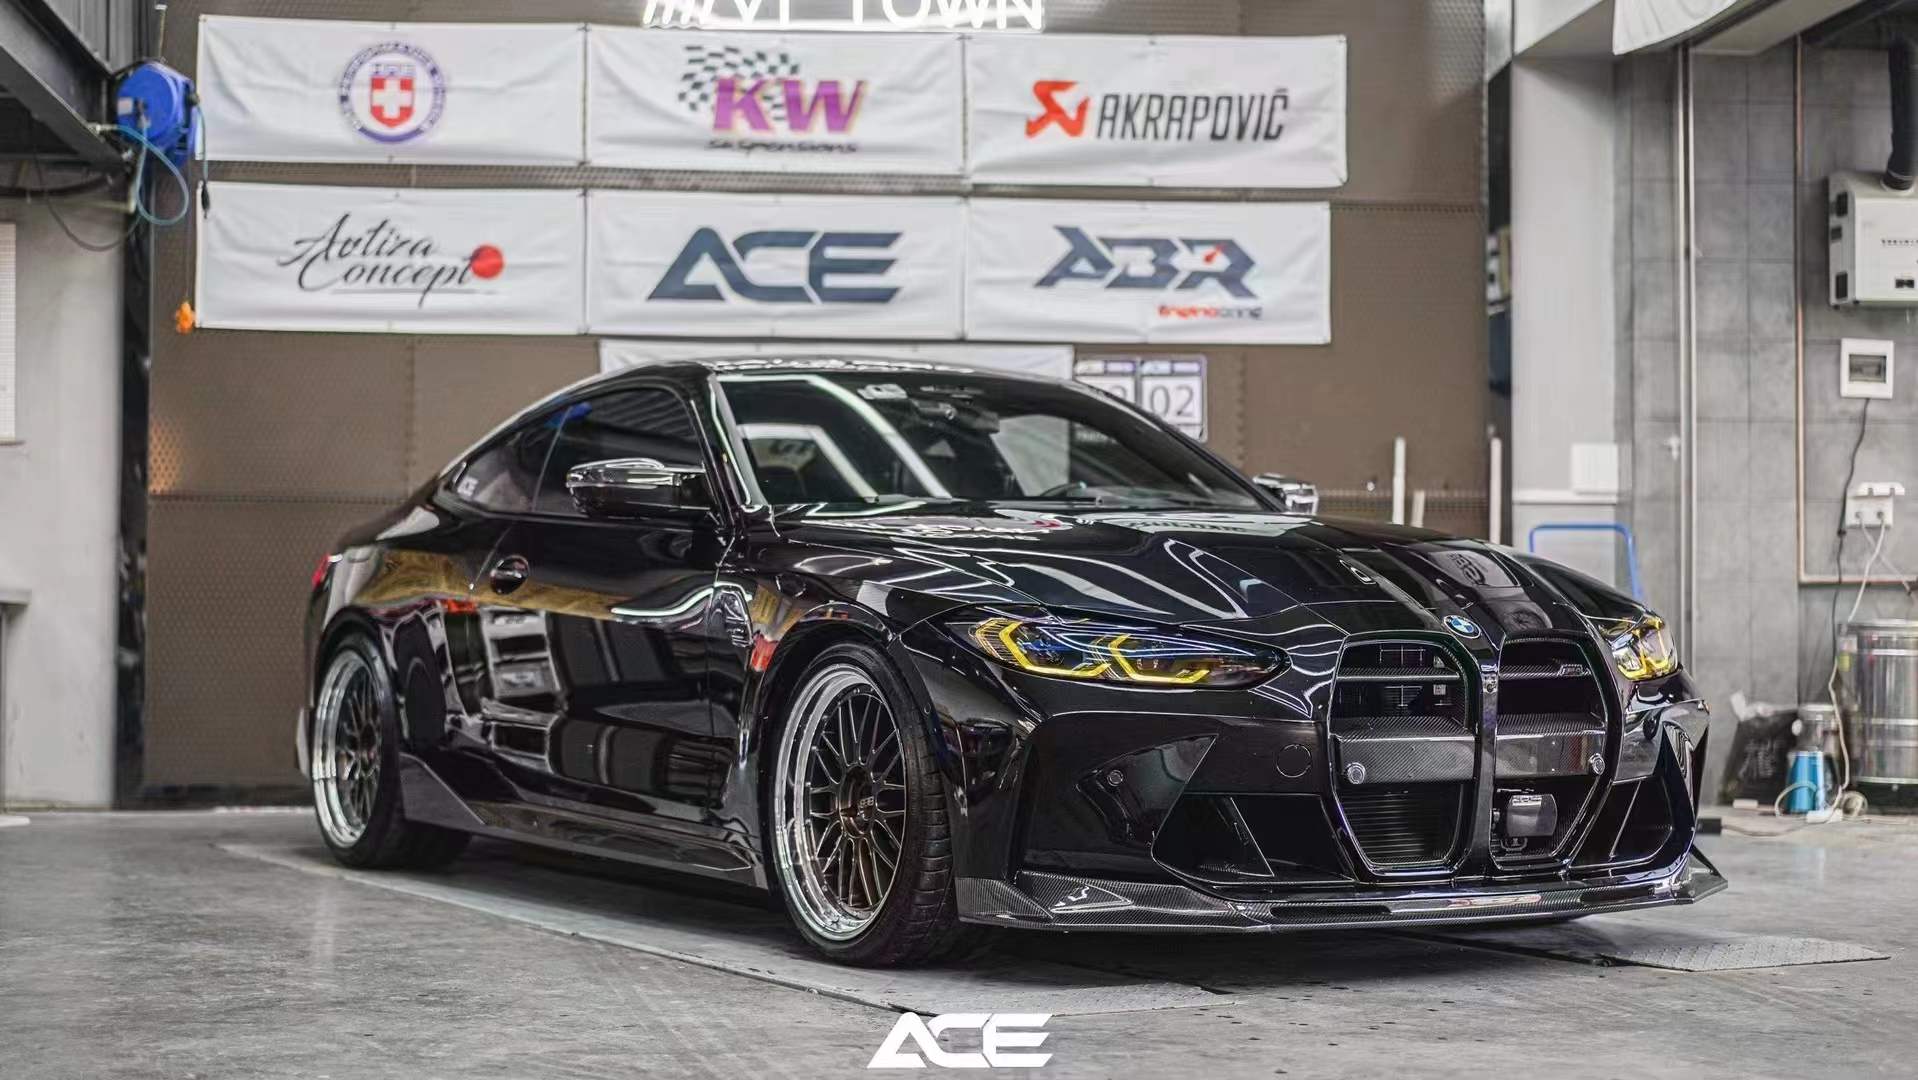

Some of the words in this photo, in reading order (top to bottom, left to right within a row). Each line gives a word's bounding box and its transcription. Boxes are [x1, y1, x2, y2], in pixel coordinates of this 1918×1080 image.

[712, 78, 867, 133] KW
[298, 248, 482, 308] Concept
[648, 227, 902, 304] ACE
[1034, 225, 1258, 299] ABR
[1150, 384, 1194, 418] 02
